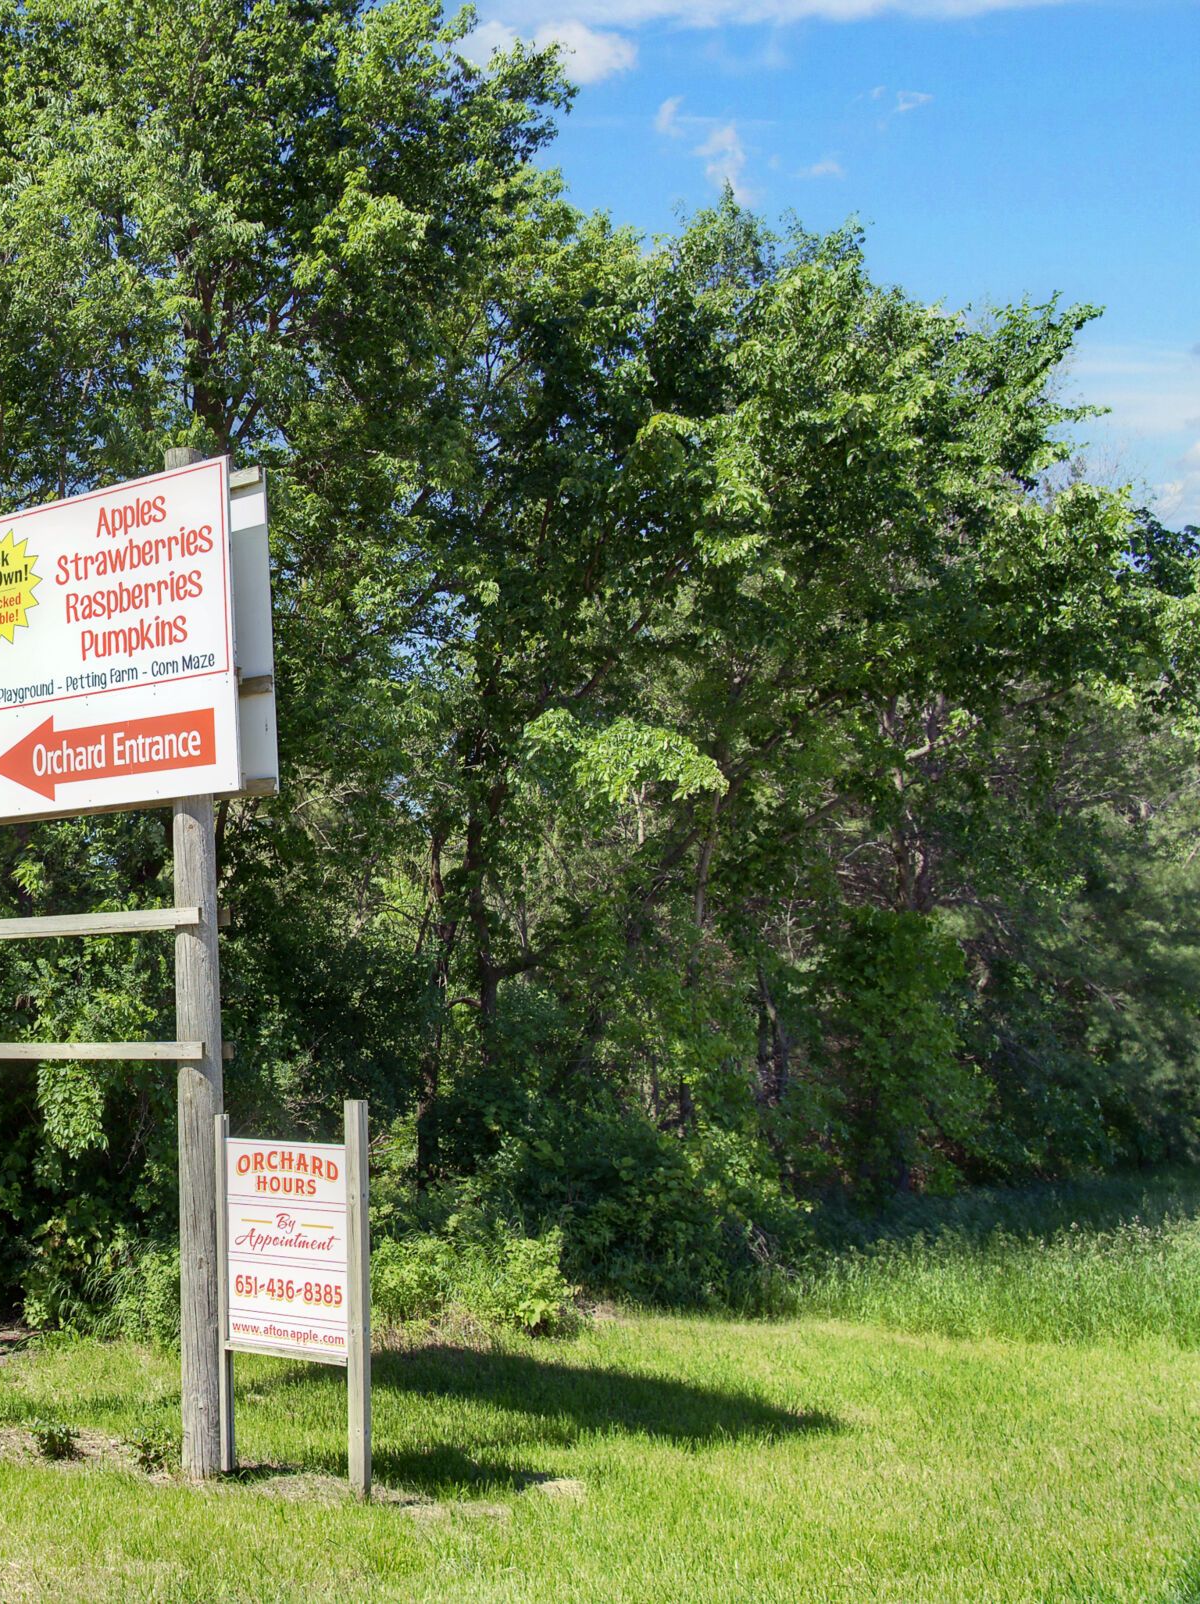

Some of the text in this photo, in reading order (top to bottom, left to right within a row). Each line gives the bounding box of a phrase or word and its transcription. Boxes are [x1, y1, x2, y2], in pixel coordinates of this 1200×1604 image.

[96, 495, 167, 538] Apples
[55, 524, 213, 585] Strawberries
[65, 570, 203, 624] Raspberries
[80, 615, 188, 661] Pumpkins
[65, 669, 106, 693] Petting
[109, 666, 138, 684] Farm
[151, 660, 179, 677] Corn
[181, 652, 215, 670] Maze
[32, 729, 200, 777] Orchard Entrance
[236, 1150, 339, 1182] ORCHARD
[256, 1175, 316, 1196] HOURS
[235, 1228, 341, 1252] Appointment
[276, 1213, 296, 1233] By
[235, 1274, 343, 1308] 651-436-8385
[232, 1321, 344, 1345] www.aftonapple.com
